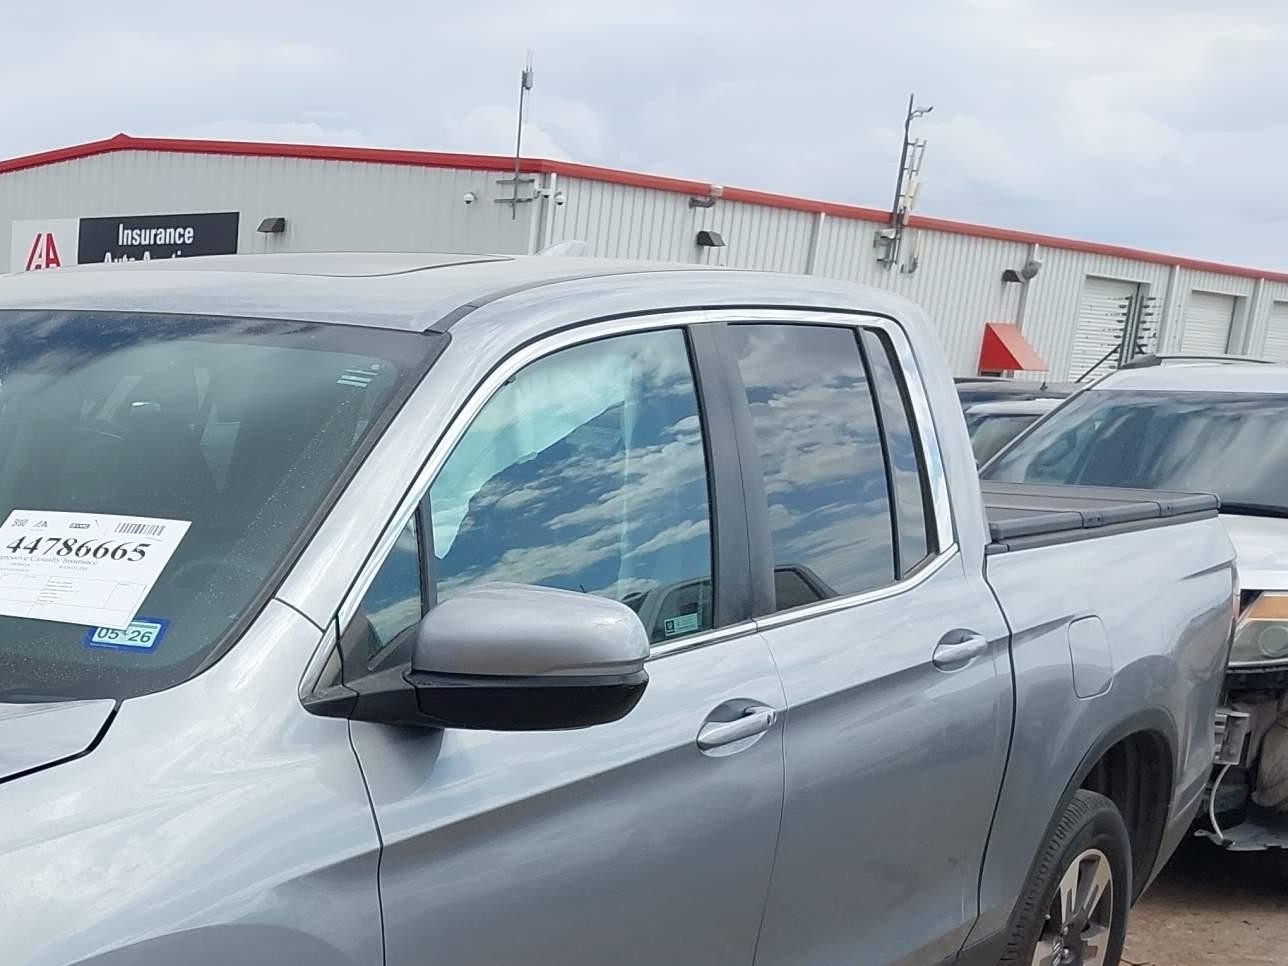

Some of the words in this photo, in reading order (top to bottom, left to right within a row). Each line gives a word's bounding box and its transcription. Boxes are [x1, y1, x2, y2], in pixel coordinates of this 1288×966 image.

[118, 224, 194, 246] Insurance
[104, 252, 136, 264] At
[6, 536, 151, 562] 44786665
[97, 627, 120, 640] 05
[128, 629, 153, 643] 26
